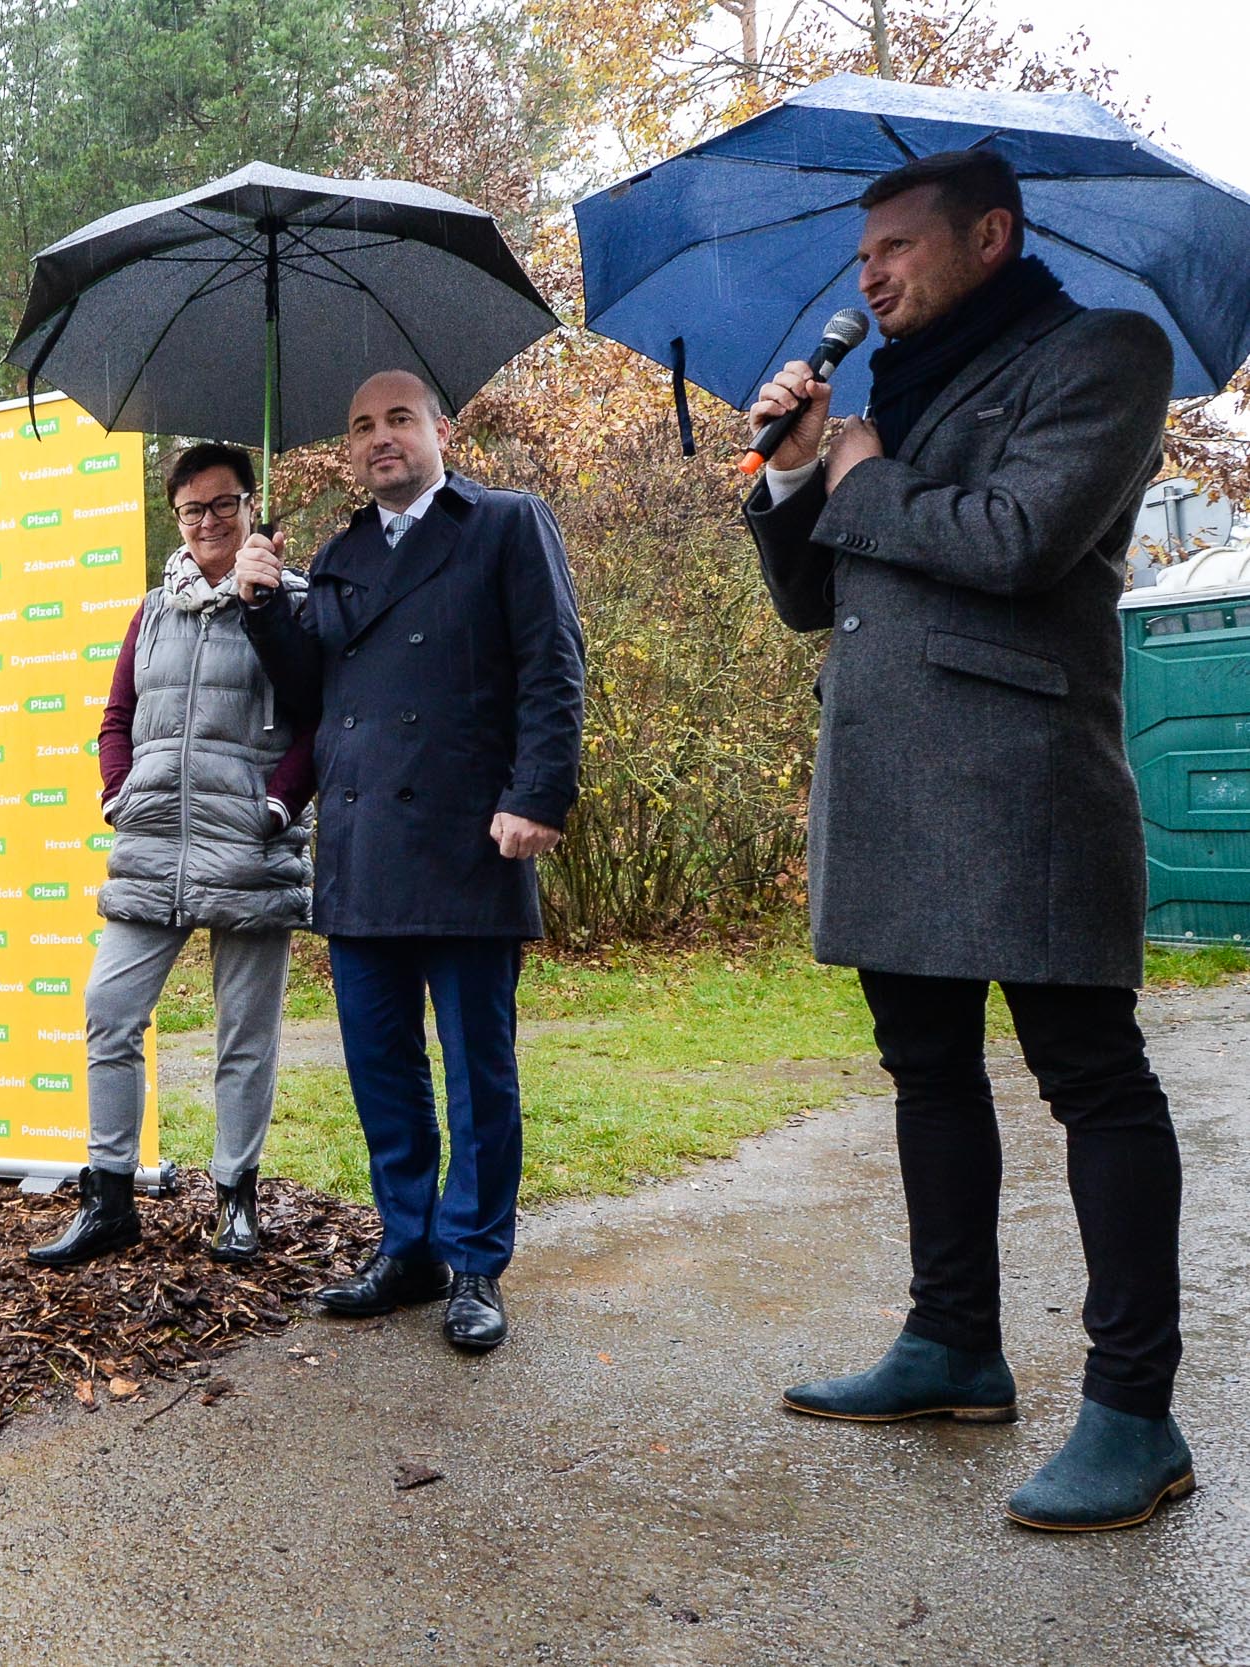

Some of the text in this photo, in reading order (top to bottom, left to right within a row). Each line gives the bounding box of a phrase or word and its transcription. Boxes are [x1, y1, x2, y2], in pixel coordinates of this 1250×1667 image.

[19, 456, 116, 481] Vzdělaná Plzeň
[73, 500, 138, 520] Rozmanitá
[26, 512, 58, 526] Plzeň
[24, 550, 118, 572] Zábavná Plzeň
[81, 594, 141, 613] Sportovní
[29, 605, 60, 618] Plzeň
[10, 649, 78, 668] Dynamická
[30, 698, 62, 710] Plzeň
[37, 744, 80, 757] Zdravá
[32, 791, 64, 803] Plzeň
[45, 839, 82, 850] Hravá
[34, 886, 66, 897] Plzeň
[30, 933, 83, 944] Oblíbená
[36, 981, 68, 992] Plzeň
[38, 1028, 85, 1044] Nejlepší
[37, 1077, 69, 1089] Plzeň
[21, 1124, 87, 1140] Pomáhající
